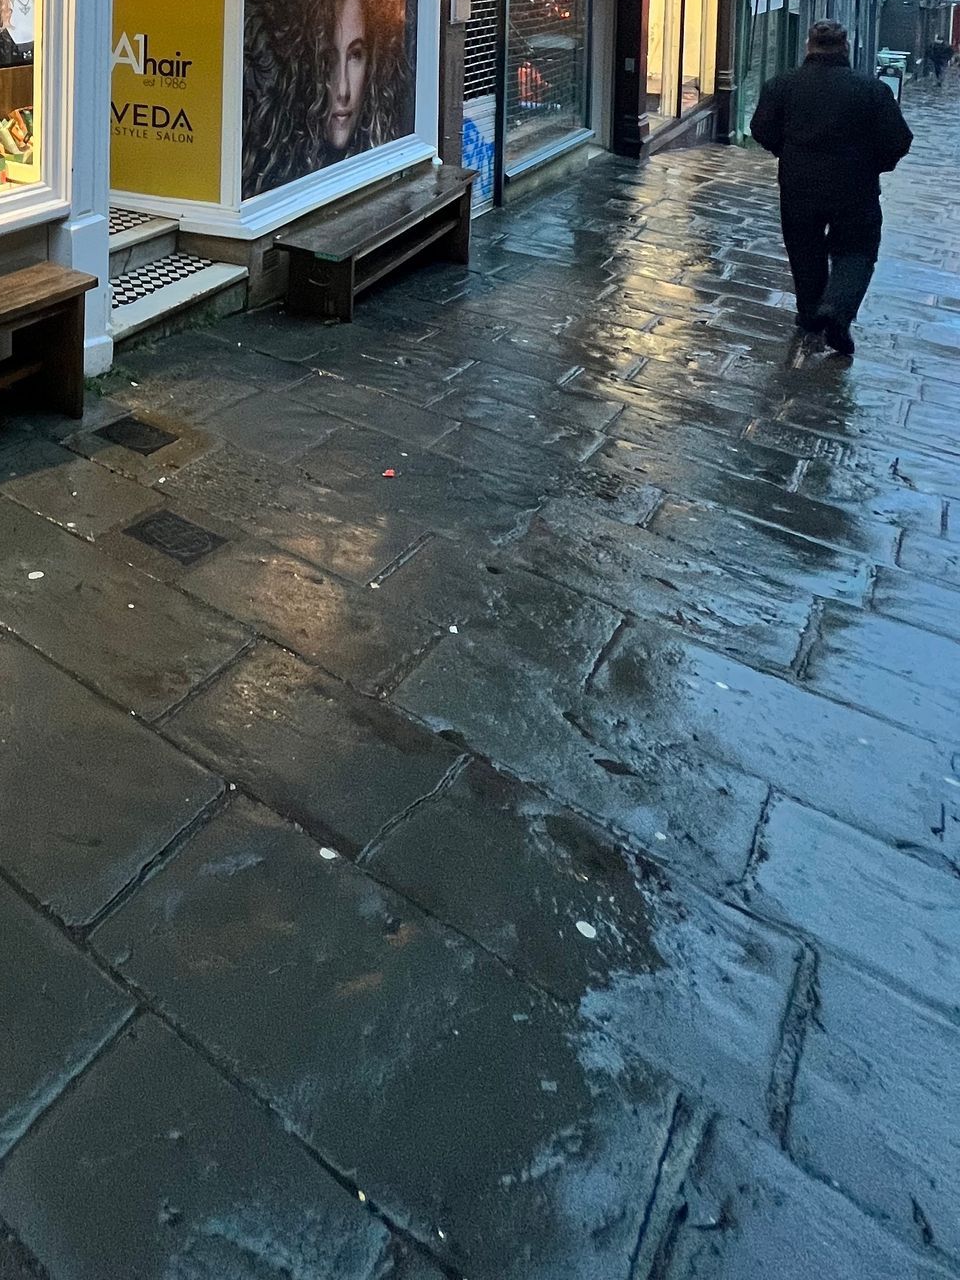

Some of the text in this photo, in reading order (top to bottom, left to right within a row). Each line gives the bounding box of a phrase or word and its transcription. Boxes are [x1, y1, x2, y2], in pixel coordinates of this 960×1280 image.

[111, 31, 192, 78] A1hair
[143, 77, 187, 90] est 1986
[110, 101, 193, 131] VEDA
[111, 127, 194, 144] STYLE SALON
